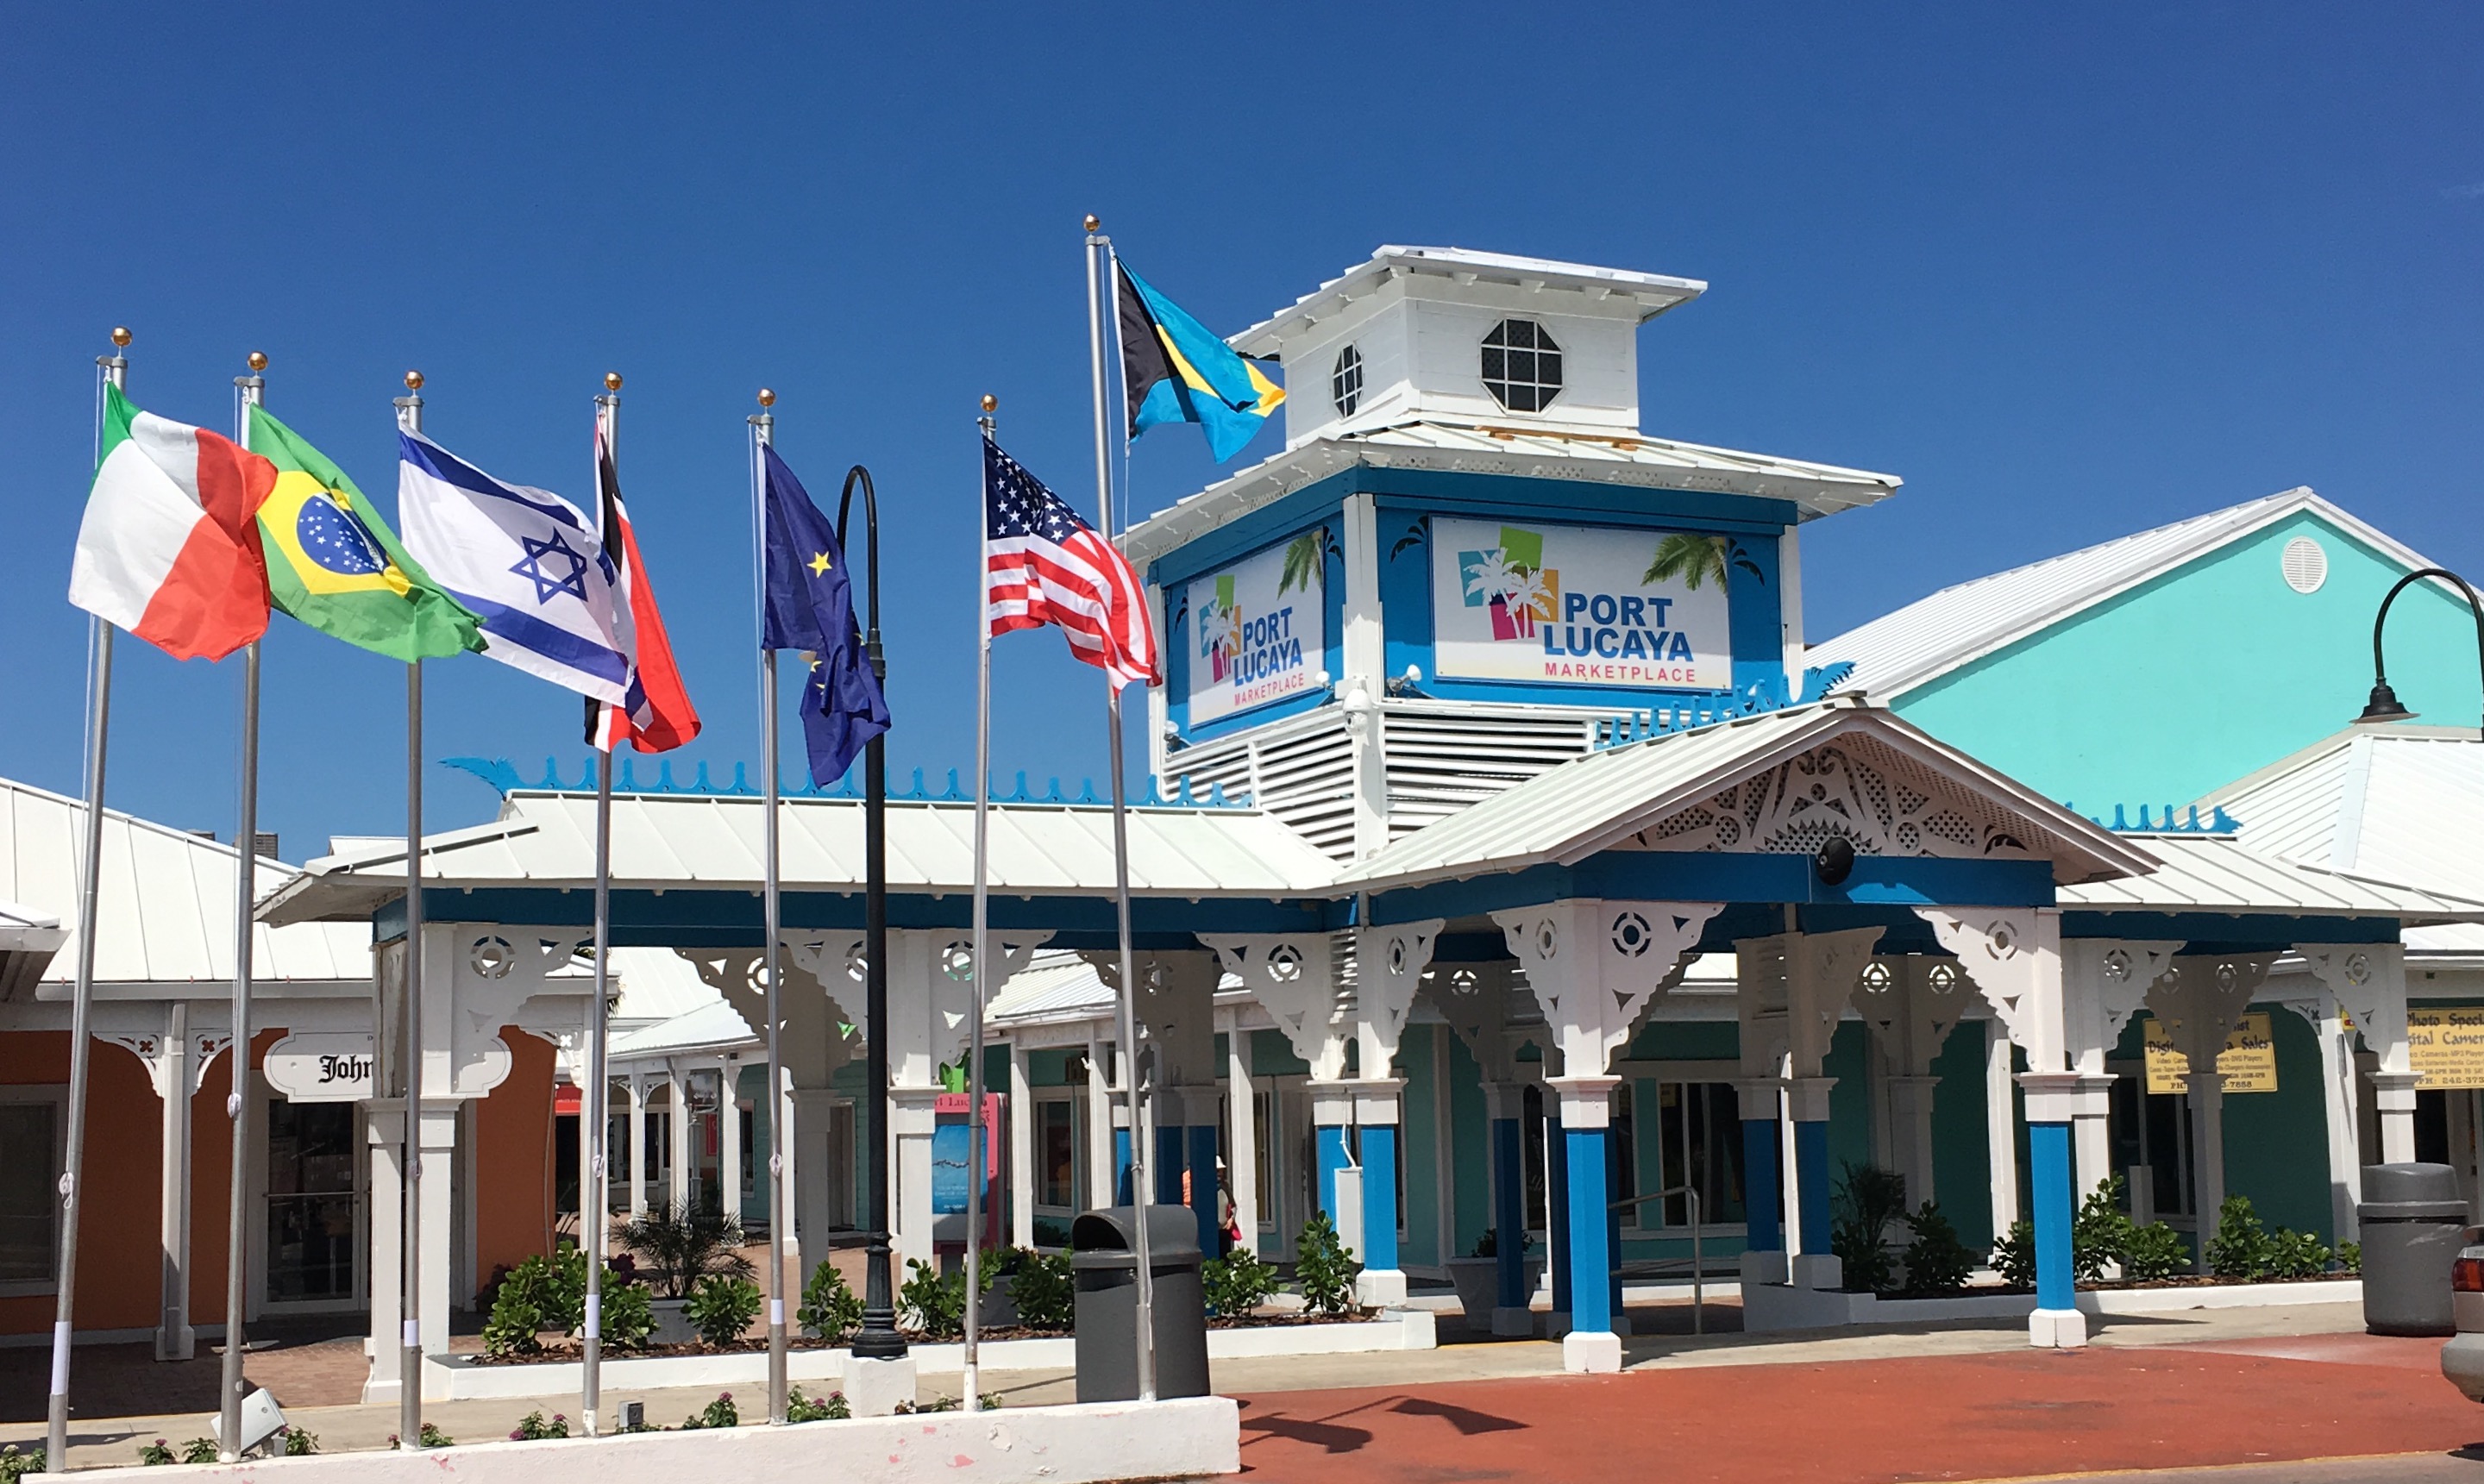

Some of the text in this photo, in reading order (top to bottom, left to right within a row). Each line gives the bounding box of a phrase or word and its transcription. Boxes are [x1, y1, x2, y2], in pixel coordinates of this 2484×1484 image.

[1565, 592, 1673, 628] PORT
[1243, 606, 1292, 652] PORT
[1543, 625, 1694, 662] LUCAYA
[1234, 637, 1303, 687] LUCAYA
[1545, 662, 1696, 682] MARKETPLACE
[1234, 673, 1304, 705] MARKETPLACE
[2449, 1013, 2484, 1030] Speci
[2148, 1040, 2174, 1056] Digit
[2242, 1035, 2269, 1049] Sales
[2408, 1030, 2484, 1048] gital Camer
